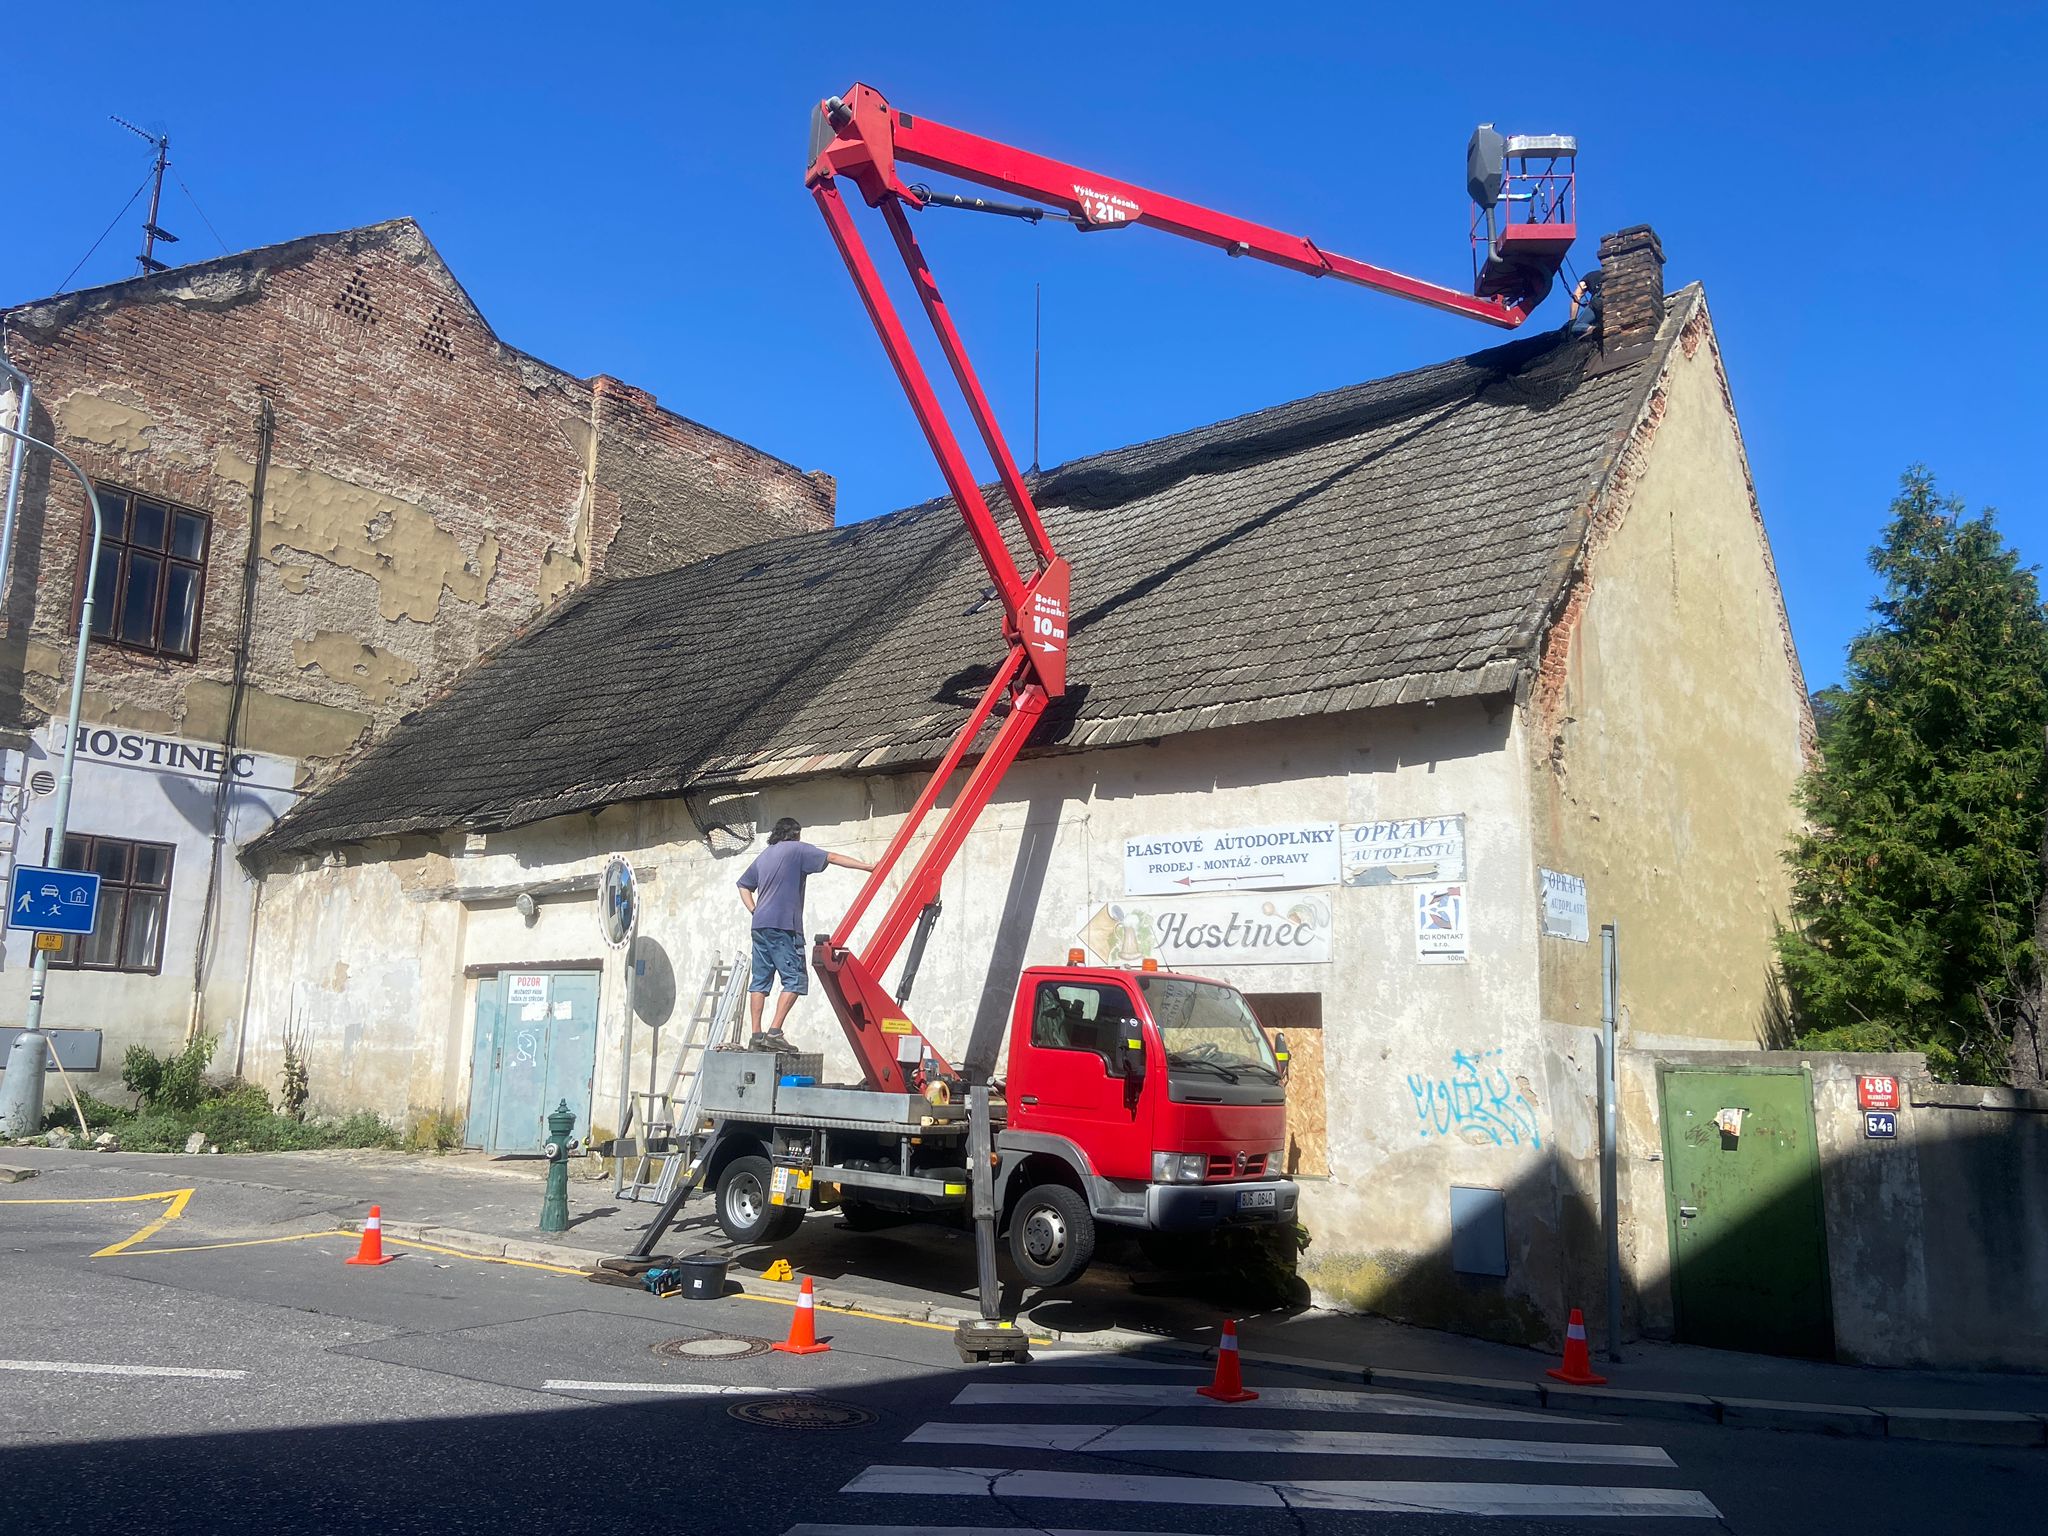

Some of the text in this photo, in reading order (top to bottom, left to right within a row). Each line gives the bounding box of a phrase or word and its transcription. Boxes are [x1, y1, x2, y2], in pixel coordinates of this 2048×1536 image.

[1073, 184, 1110, 203] Výškový
[1034, 602, 1065, 617] dosah:
[1035, 592, 1061, 607] Boční
[1033, 615, 1065, 639] 10m
[61, 723, 255, 778] HOSTINEC
[1354, 819, 1450, 843] OPRAVY
[1126, 828, 1335, 857] PLASTOVÉ AUTODOPLŇKY
[1352, 840, 1456, 861] AUTOPLASTŮ
[1148, 861, 1193, 874] PRODEJ
[1203, 855, 1251, 871] MONTÁŽ
[1260, 853, 1309, 867] OPRAVY
[1154, 912, 1316, 949] Hostinec
[517, 976, 541, 987] POZOR
[1865, 1078, 1893, 1093] 486
[1868, 1117, 1893, 1132] 54a
